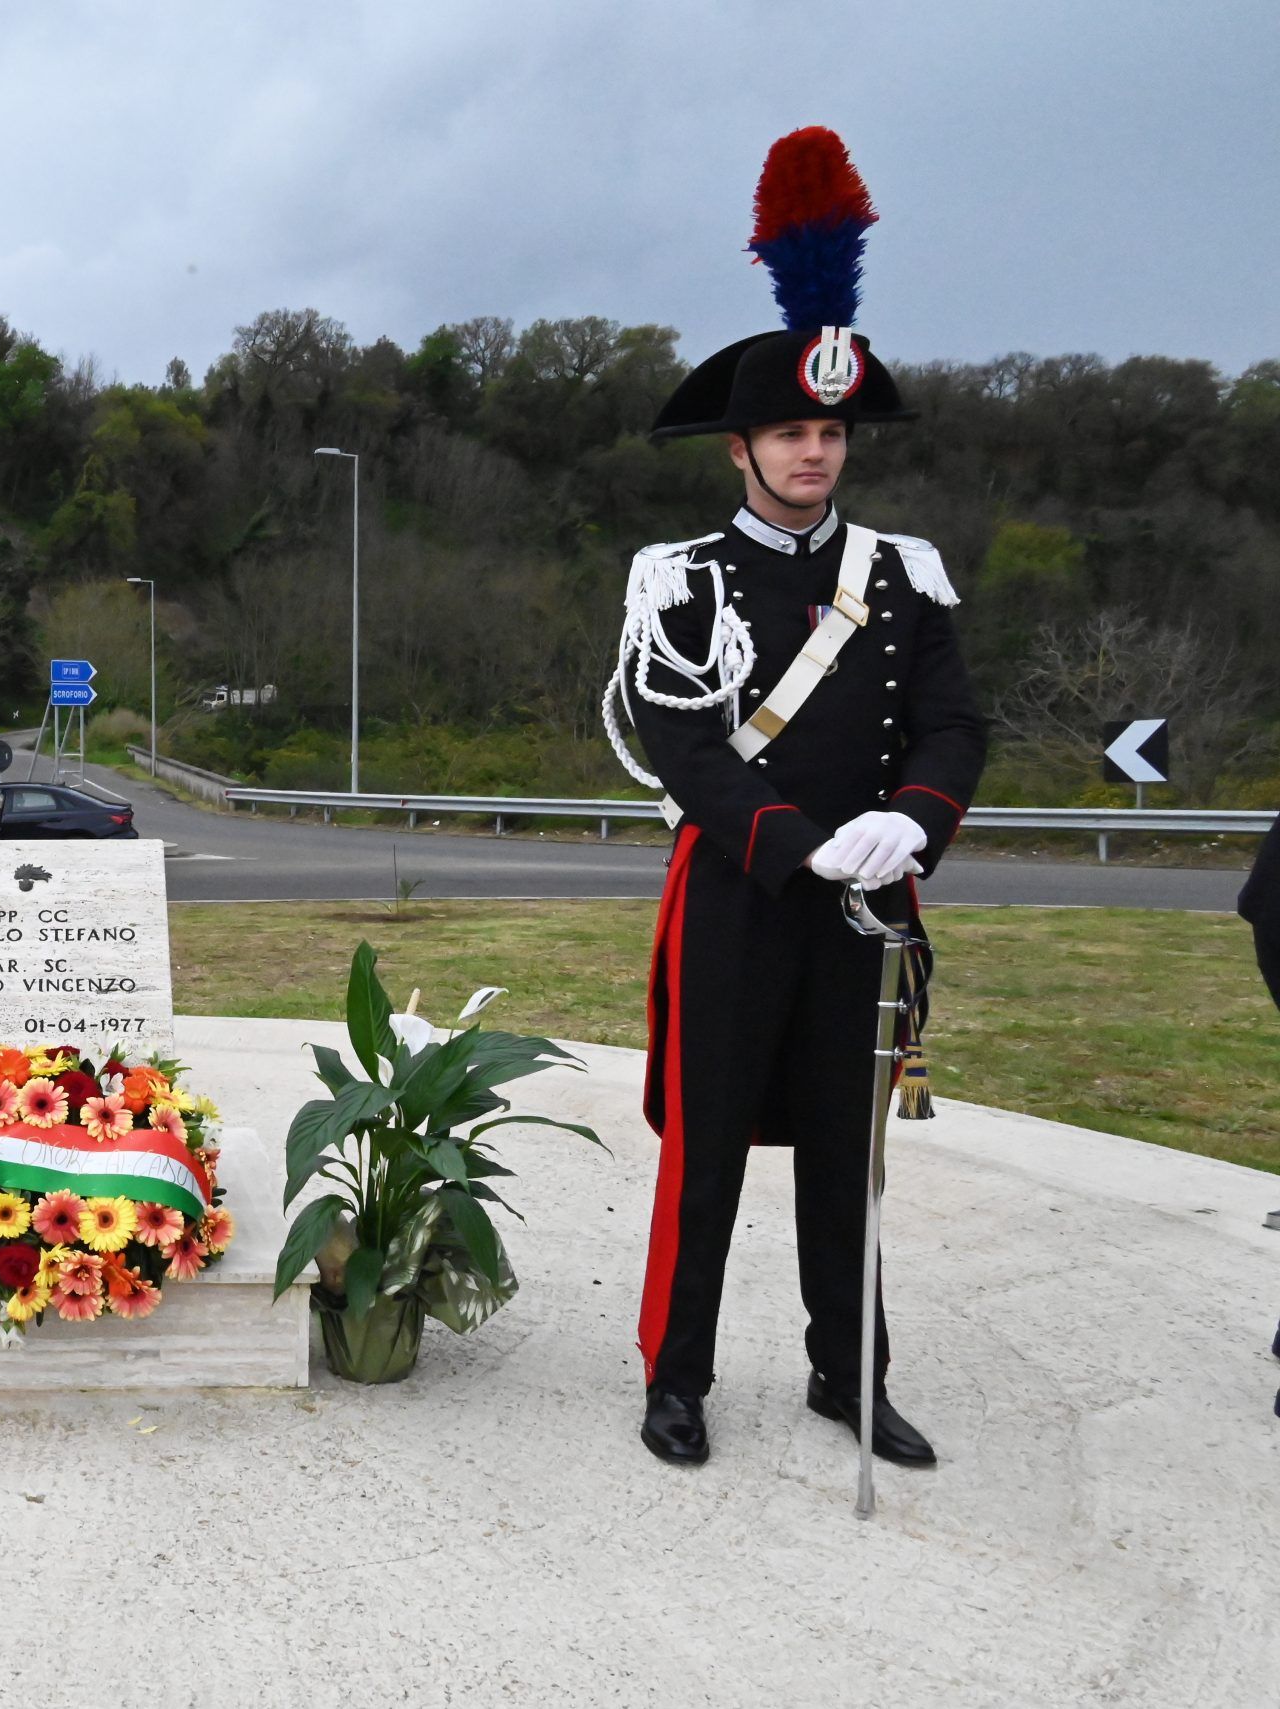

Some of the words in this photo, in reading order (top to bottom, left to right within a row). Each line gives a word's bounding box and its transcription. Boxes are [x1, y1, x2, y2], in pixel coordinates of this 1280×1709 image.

[38, 909, 69, 923] CC
[38, 928, 136, 943] STEFANO
[22, 978, 137, 993] VINCENZO
[24, 1017, 147, 1033] 01-04-1977
